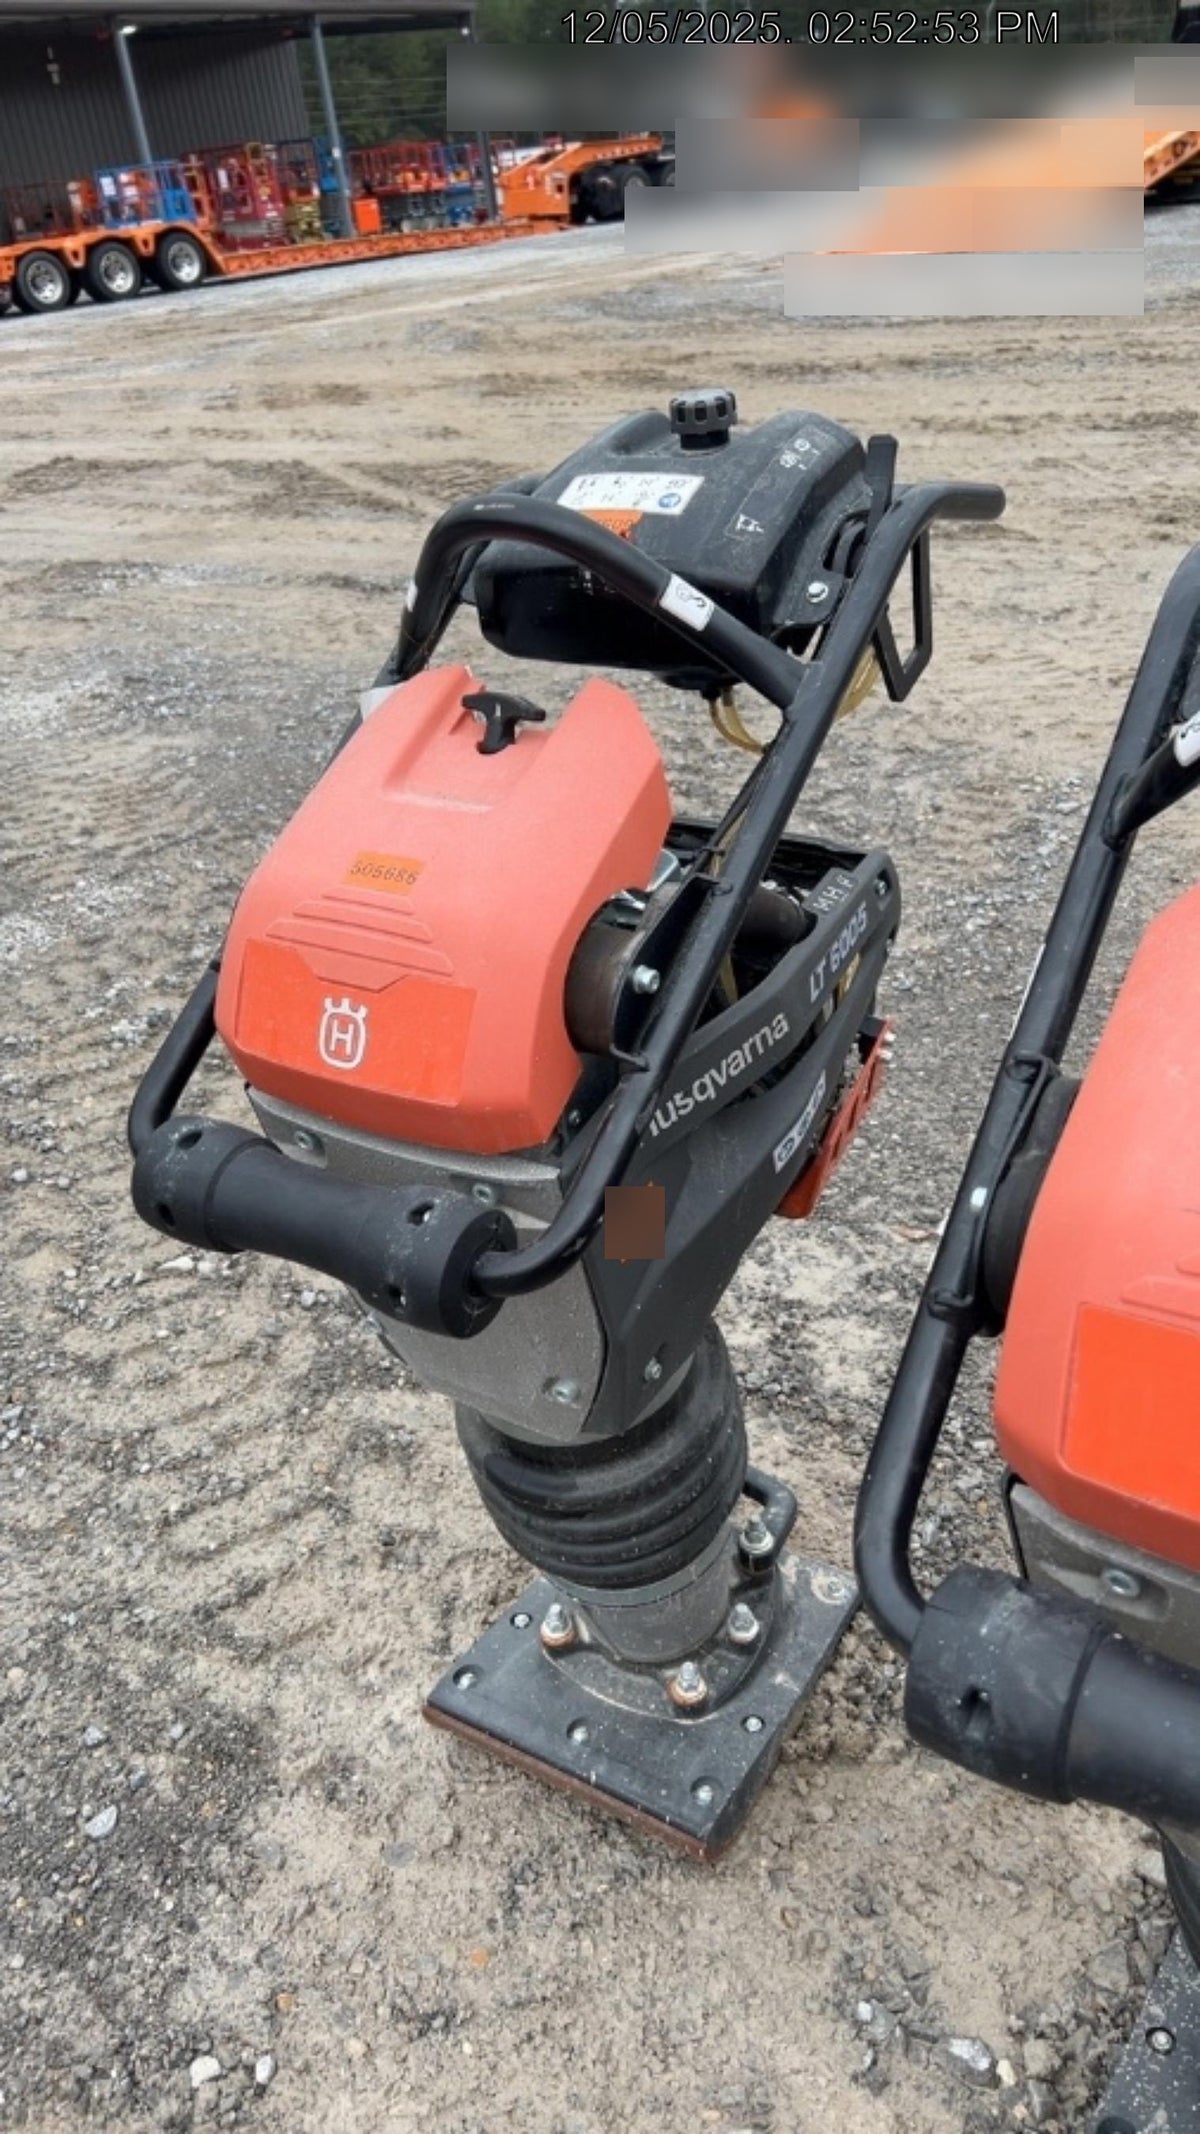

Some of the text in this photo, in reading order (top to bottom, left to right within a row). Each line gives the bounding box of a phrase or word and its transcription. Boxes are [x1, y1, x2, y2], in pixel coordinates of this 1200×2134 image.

[350, 860, 419, 885] 505686
[810, 900, 867, 1003] LT 6005
